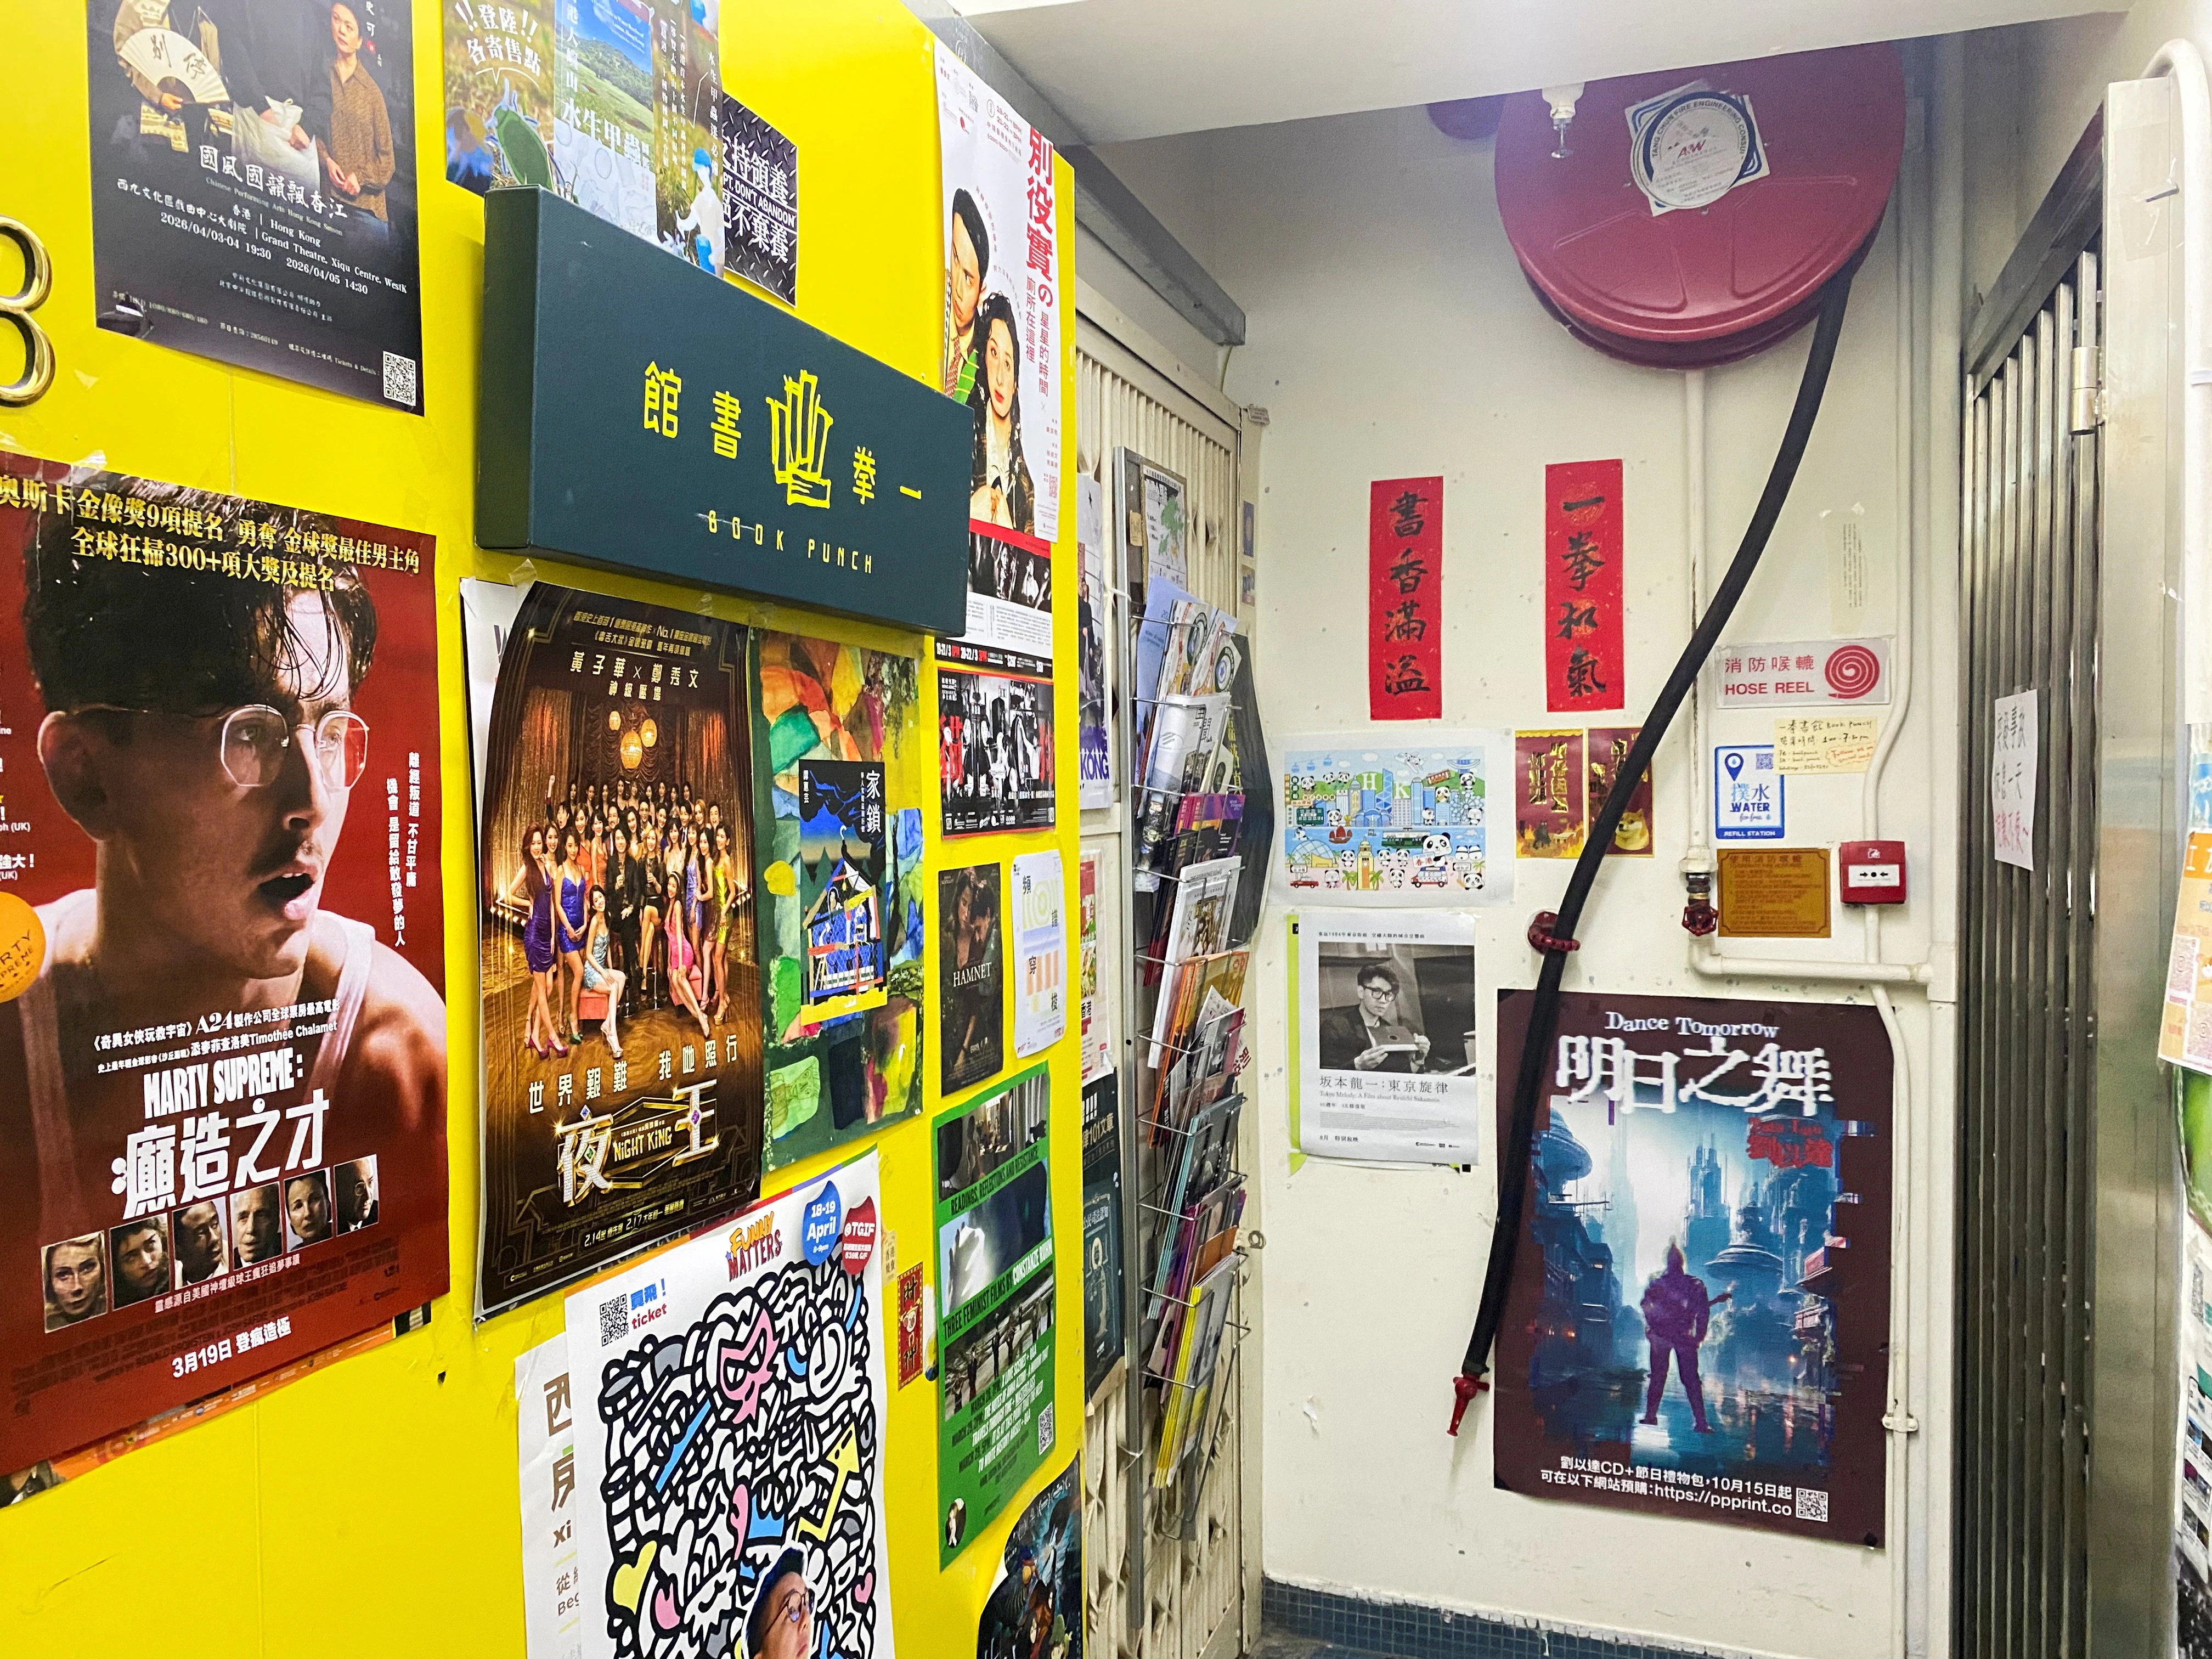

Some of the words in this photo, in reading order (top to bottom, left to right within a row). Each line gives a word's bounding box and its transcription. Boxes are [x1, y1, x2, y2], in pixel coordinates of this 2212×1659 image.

[467, 35, 541, 77] 各寄售點
[1651, 134, 1661, 158] TANG
[1657, 114, 1675, 136] CHUN
[1674, 103, 1691, 117] FIRE
[1693, 99, 1741, 126] ENGINEERING
[199, 145, 348, 219] 國風國韻飄香江
[233, 204, 251, 220] 香港
[270, 219, 295, 238] Hong
[298, 229, 321, 247] Kong
[758, 196, 795, 228] ABANDON
[161, 212, 239, 249] 2026/04/03-04
[246, 242, 272, 260] 19:30
[286, 257, 341, 285] 2026/04/05
[345, 279, 368, 295] 14:30
[261, 232, 289, 250] Grand
[331, 257, 351, 273] Xiqu
[385, 277, 407, 294] WestK
[70, 526, 336, 592] 全球狂掃300+項大獎及提名
[237, 518, 276, 550] 勇奪
[283, 525, 421, 574] 金球獎最佳男主角
[707, 509, 785, 552] BOOK
[808, 538, 873, 574] PUNCH
[1384, 490, 1431, 696] 書香滿溢
[1555, 495, 1607, 698] 一拳和氣
[571, 651, 627, 679] 黃子華
[651, 663, 699, 689] 鄭秀文
[1724, 654, 1815, 673] 消防喉轆
[1725, 682, 1768, 696] HOSE
[1775, 681, 1815, 693] REEL
[1080, 748, 1110, 780] KONG
[866, 770, 882, 834] 家鎖
[1729, 802, 1770, 813] WATER
[11, 821, 31, 833] (UK)
[952, 962, 992, 988] HAMNET
[195, 1010, 233, 1035] A24
[295, 1020, 338, 1038] Chalamet
[1605, 1011, 1669, 1033] Dance
[1674, 1016, 1780, 1039] Tomorrow
[143, 1062, 209, 1119] MARTY
[528, 1060, 628, 1115] 世界艱難
[658, 1034, 737, 1081] 我哋照行
[1555, 1034, 1834, 1117] 明日之舞
[806, 1216, 837, 1244] April
[811, 1200, 836, 1218] 18-19
[844, 1221, 876, 1237] @TGIF
[728, 1229, 783, 1282] MATTERS
[729, 1211, 775, 1259] FUNNY
[631, 1302, 668, 1329] ticket
[943, 1310, 963, 1341] THREE
[962, 1289, 990, 1327] FEMINIST
[989, 1277, 1006, 1305] FILMS
[1013, 1248, 1041, 1286] CONSTANZE
[171, 1338, 233, 1378] 3月19日
